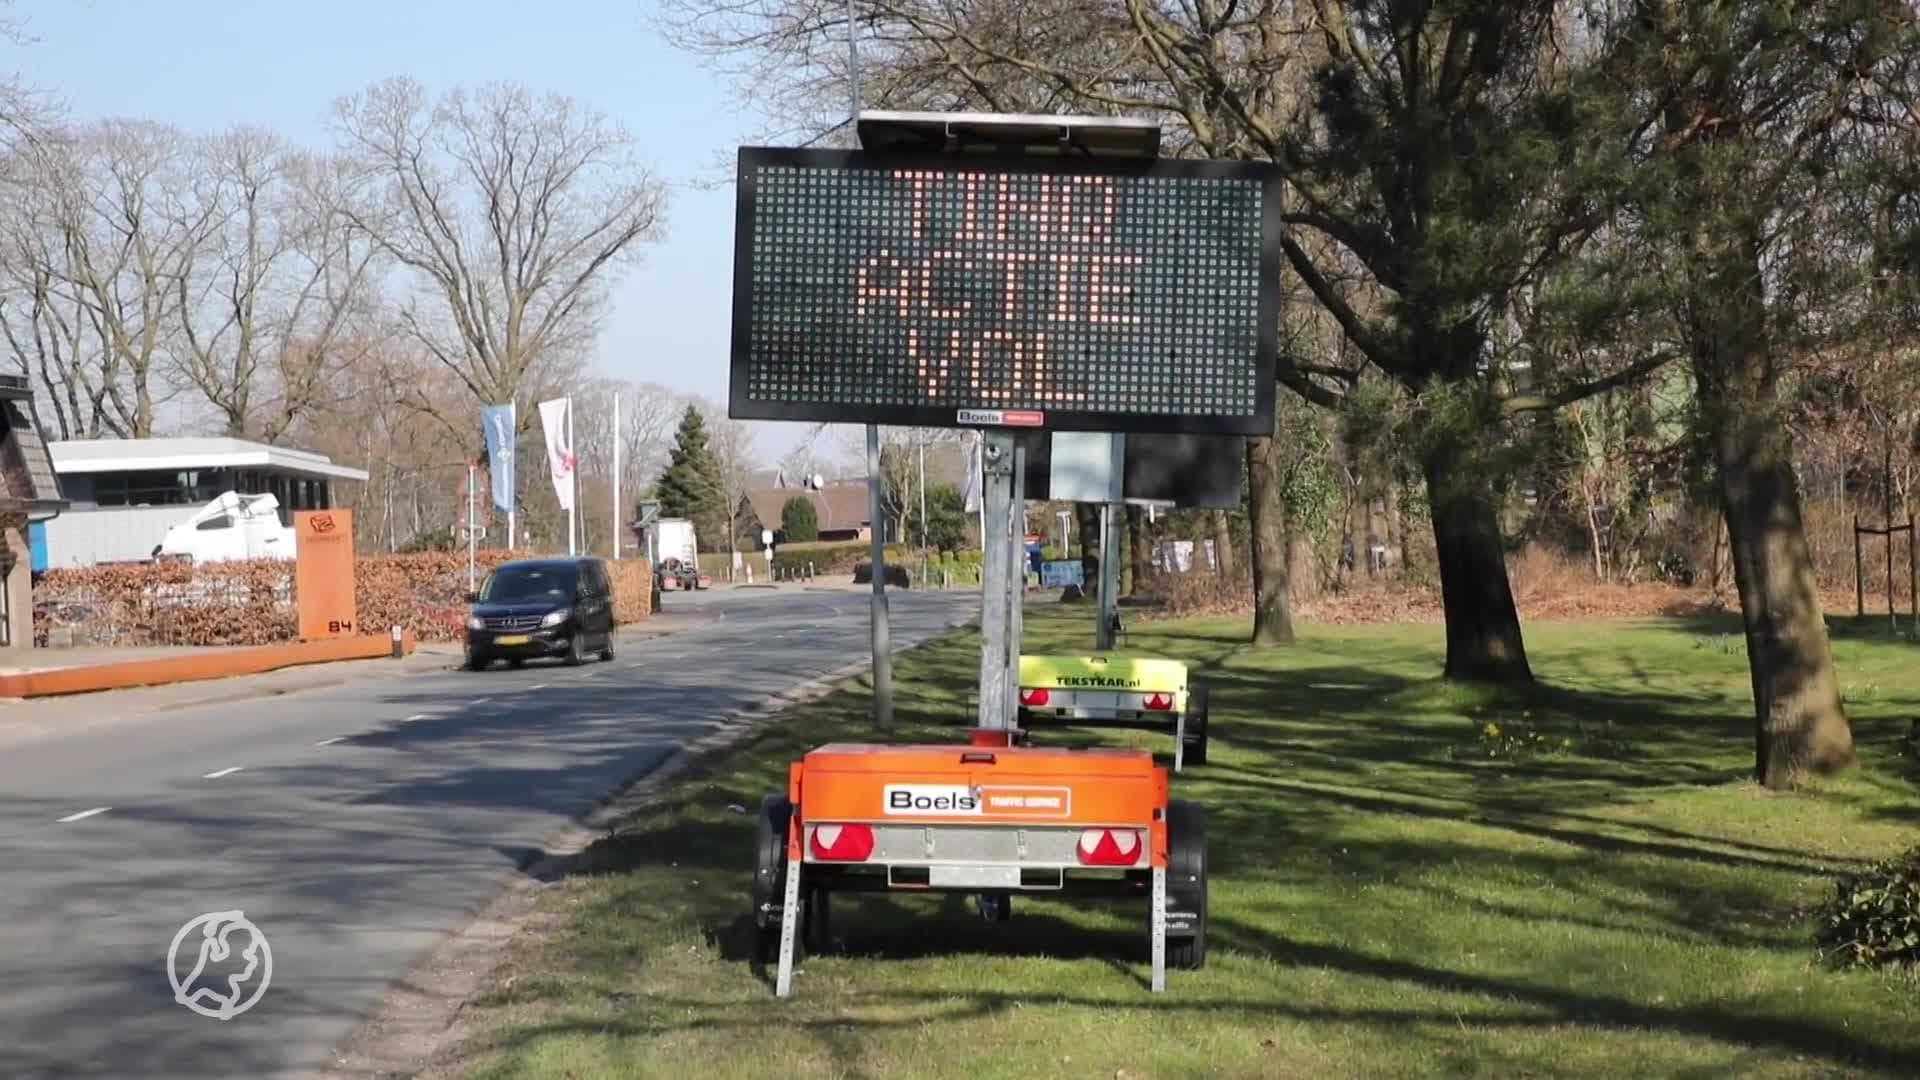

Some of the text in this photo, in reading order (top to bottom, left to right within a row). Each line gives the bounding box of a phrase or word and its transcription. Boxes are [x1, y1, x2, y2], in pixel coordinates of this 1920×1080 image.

[895, 170, 1114, 242] TINQ
[857, 248, 1142, 323] ACTIE
[909, 328, 1085, 401] VOL
[328, 621, 352, 632] 84
[1056, 677, 1140, 687] TEKSTKAR.nl
[890, 790, 977, 810] Boels
